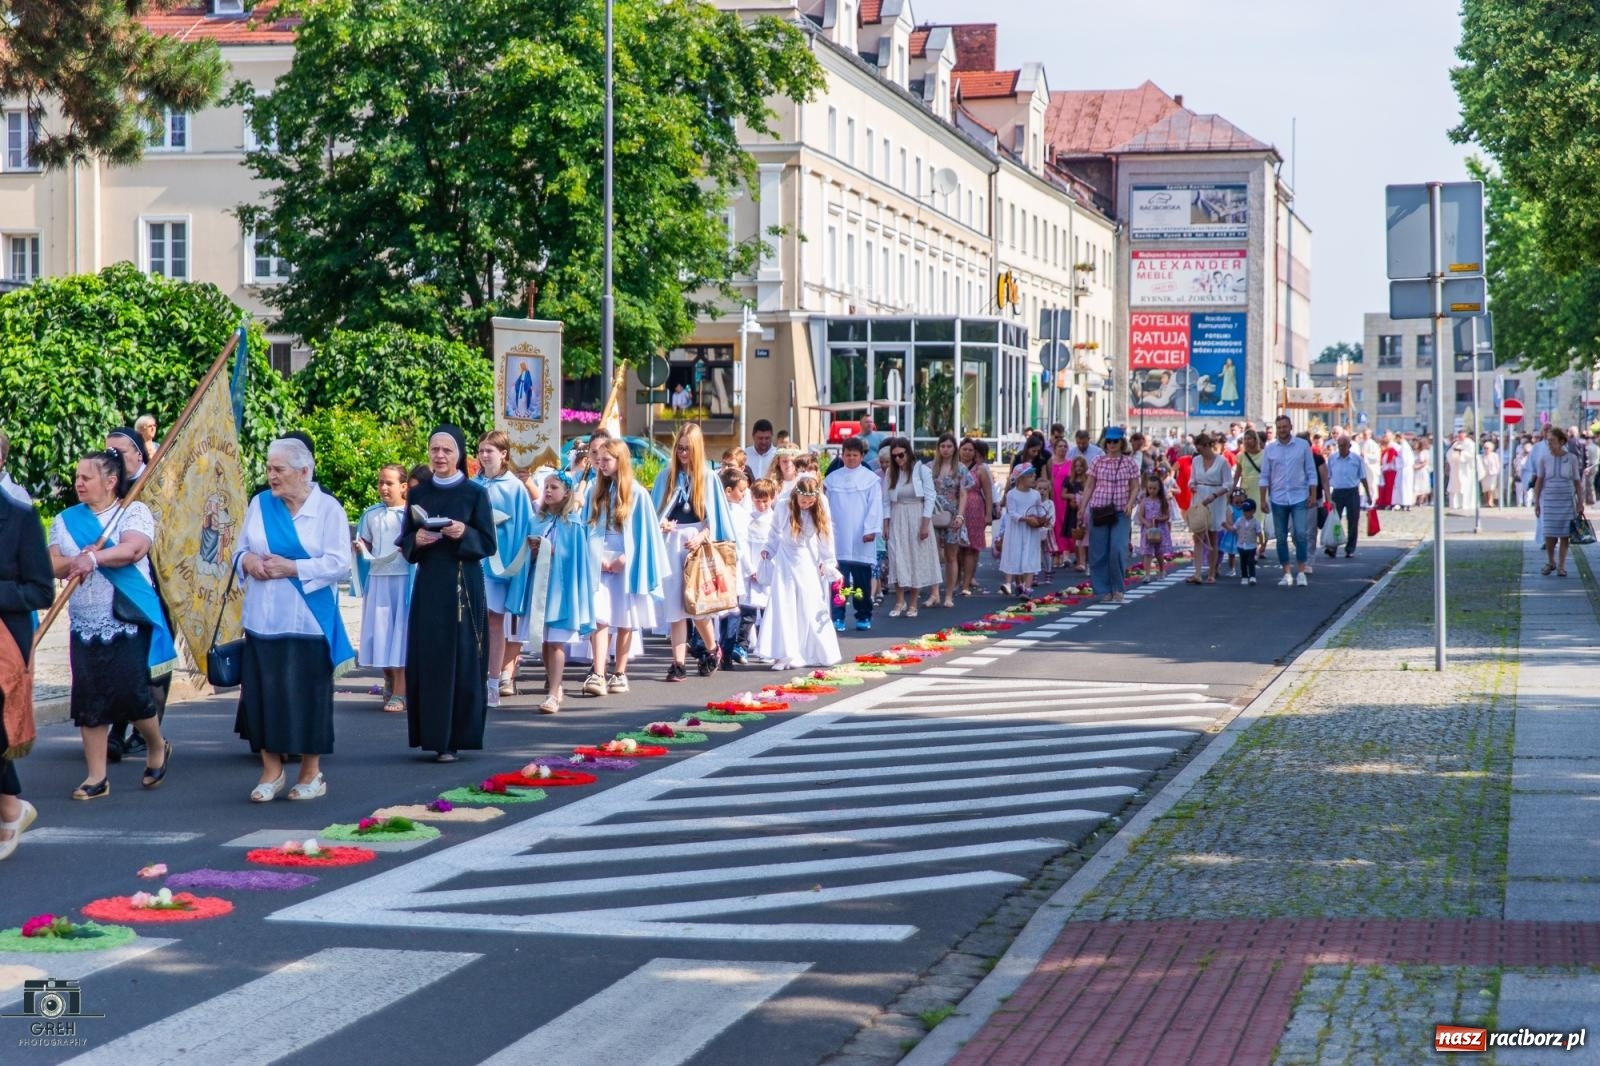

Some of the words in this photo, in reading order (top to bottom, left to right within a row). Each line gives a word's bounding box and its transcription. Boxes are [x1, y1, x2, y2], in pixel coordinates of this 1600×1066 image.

[1137, 260, 1242, 270] ALEXANDER
[1131, 315, 1189, 326] FOTELIKI
[1132, 332, 1188, 348] RATUJĄ
[1133, 348, 1185, 364] ŻYCIE!
